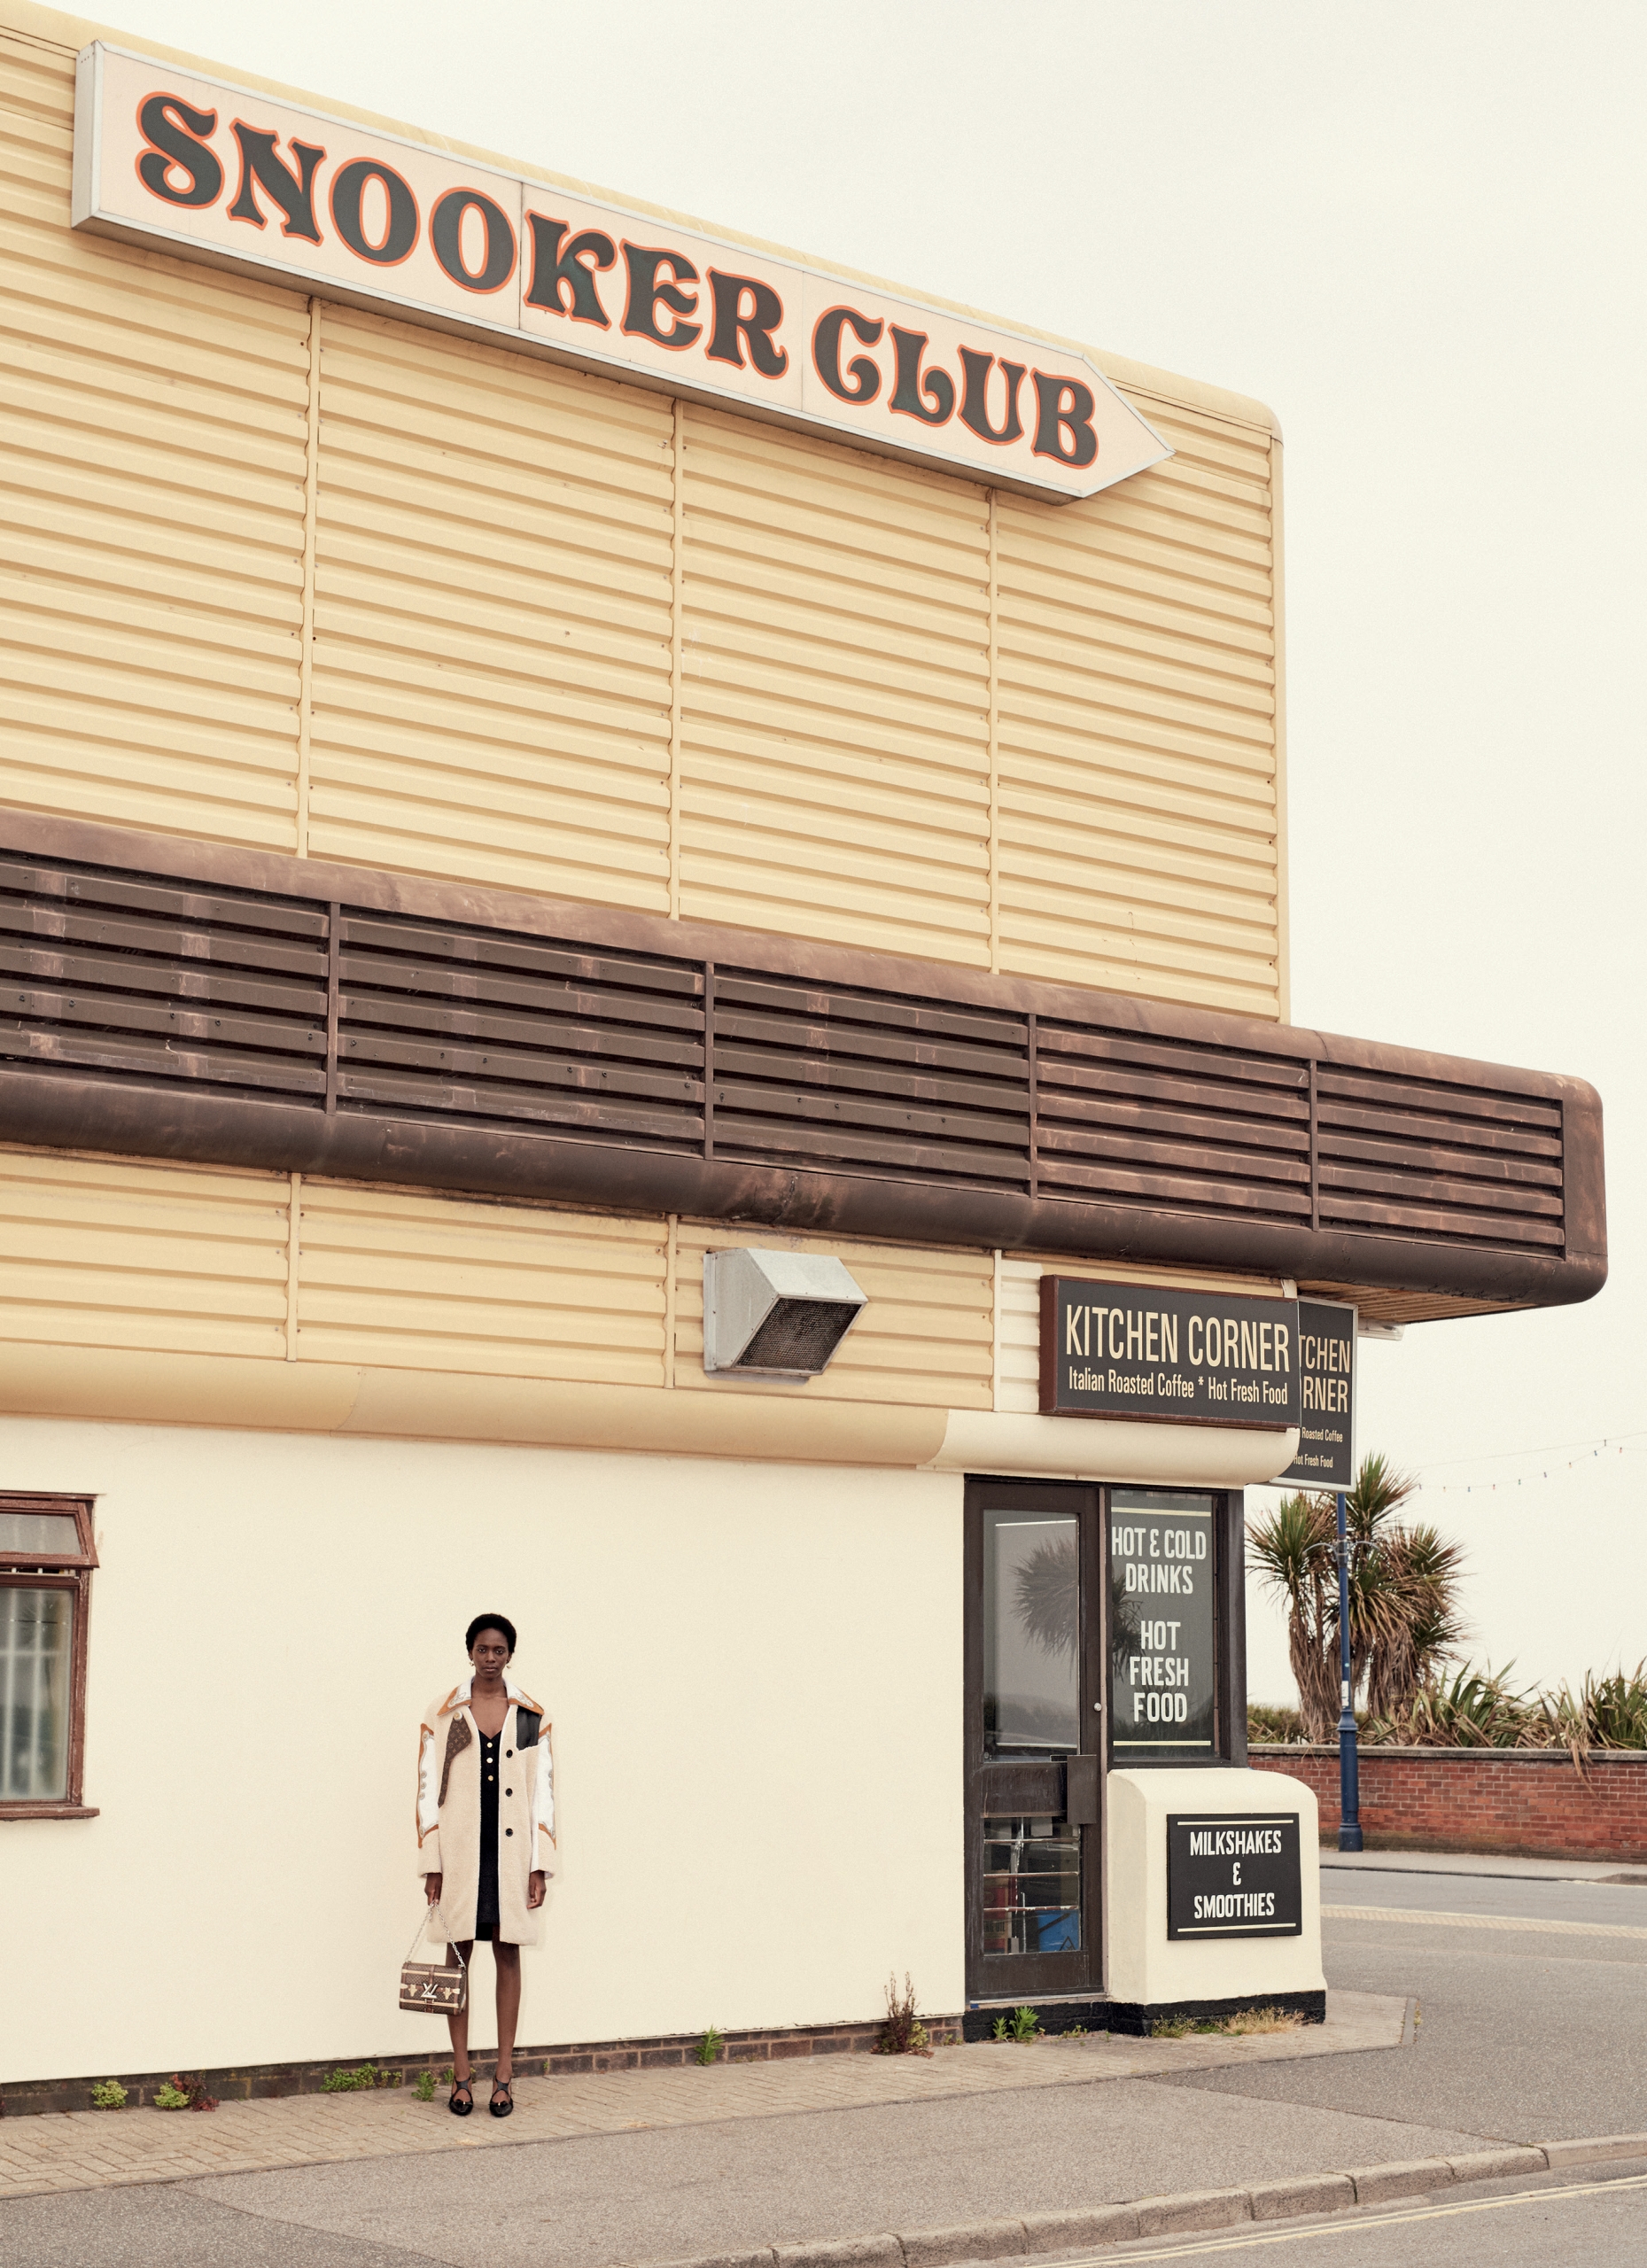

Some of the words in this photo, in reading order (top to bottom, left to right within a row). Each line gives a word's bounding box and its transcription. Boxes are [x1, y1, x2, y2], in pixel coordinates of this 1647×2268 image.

[135, 90, 789, 379] SNOOKER
[811, 304, 1100, 470] CLUB
[1066, 1304, 1178, 1363] KITCHEN
[1188, 1315, 1290, 1372] CORNER
[1068, 1366, 1106, 1392] Italian
[1108, 1370, 1154, 1395] Roasted
[1157, 1373, 1194, 1398] Coffee
[1208, 1377, 1228, 1401] Hot
[1231, 1379, 1260, 1403] Fresh
[1262, 1381, 1288, 1405] Food
[1301, 1375, 1348, 1413] RNER
[1301, 1426, 1324, 1441] Roasted
[1325, 1429, 1343, 1443] Coffee
[1304, 1454, 1319, 1467] Fresh
[1320, 1455, 1333, 1468] Food
[1111, 1526, 1146, 1557] HOT
[1164, 1529, 1207, 1560] COLD
[1125, 1563, 1193, 1594] DRINKS
[1140, 1619, 1181, 1651] HOT
[1130, 1656, 1189, 1686] FRESH
[1133, 1692, 1188, 1722] FOOD
[1190, 1829, 1282, 1856] MILKSHAKES
[1193, 1892, 1275, 1919] SMOOTHIES
